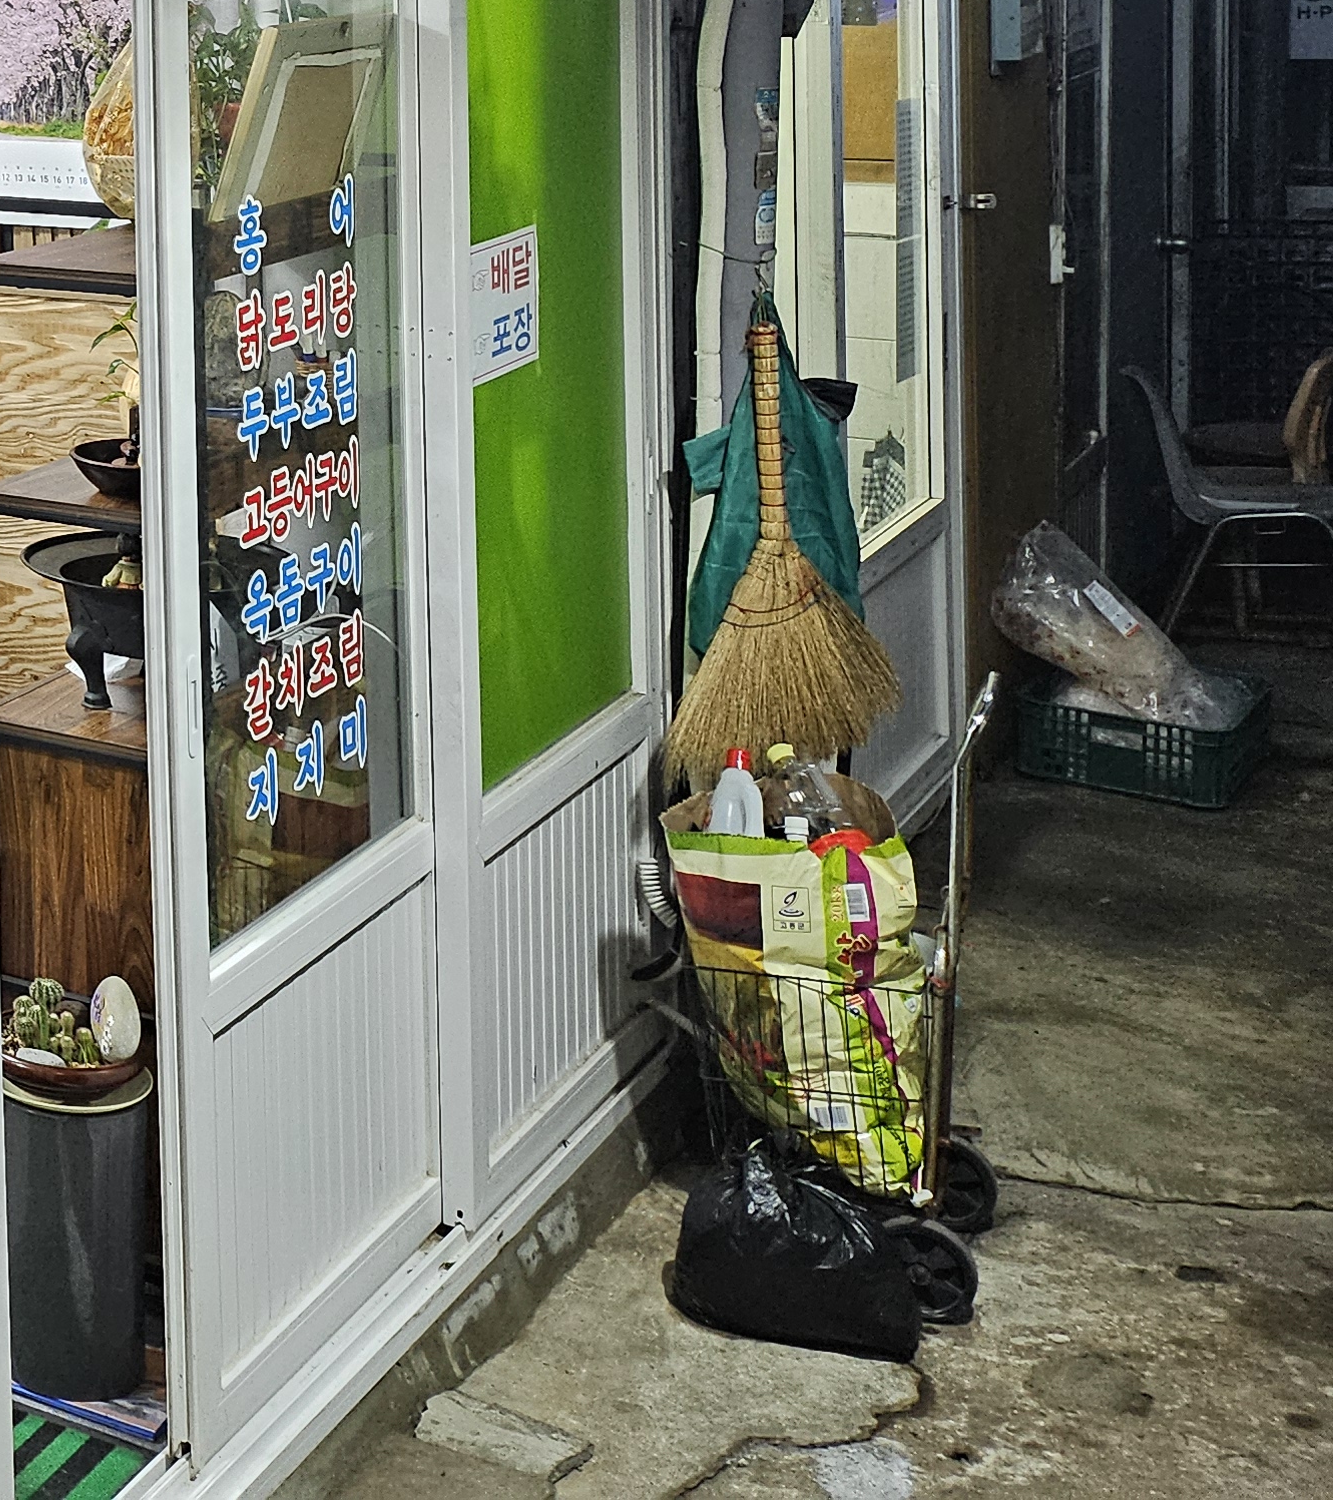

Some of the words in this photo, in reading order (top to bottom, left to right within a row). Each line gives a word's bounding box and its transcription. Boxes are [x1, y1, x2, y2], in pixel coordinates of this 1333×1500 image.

[2, 173, 10, 182] 12
[14, 174, 23, 182] 13
[27, 174, 36, 183] 14
[40, 175, 49, 183] 15
[53, 175, 62, 184] 16
[66, 176, 75, 185] 17
[236, 262, 357, 372] 닭도리탕
[490, 241, 532, 294] 배달
[491, 302, 533, 358] 포장
[238, 348, 358, 462] 두부조림
[240, 435, 360, 549] 고등어구이
[242, 522, 362, 644] 옥돔구이
[244, 608, 364, 741] 갈치조림
